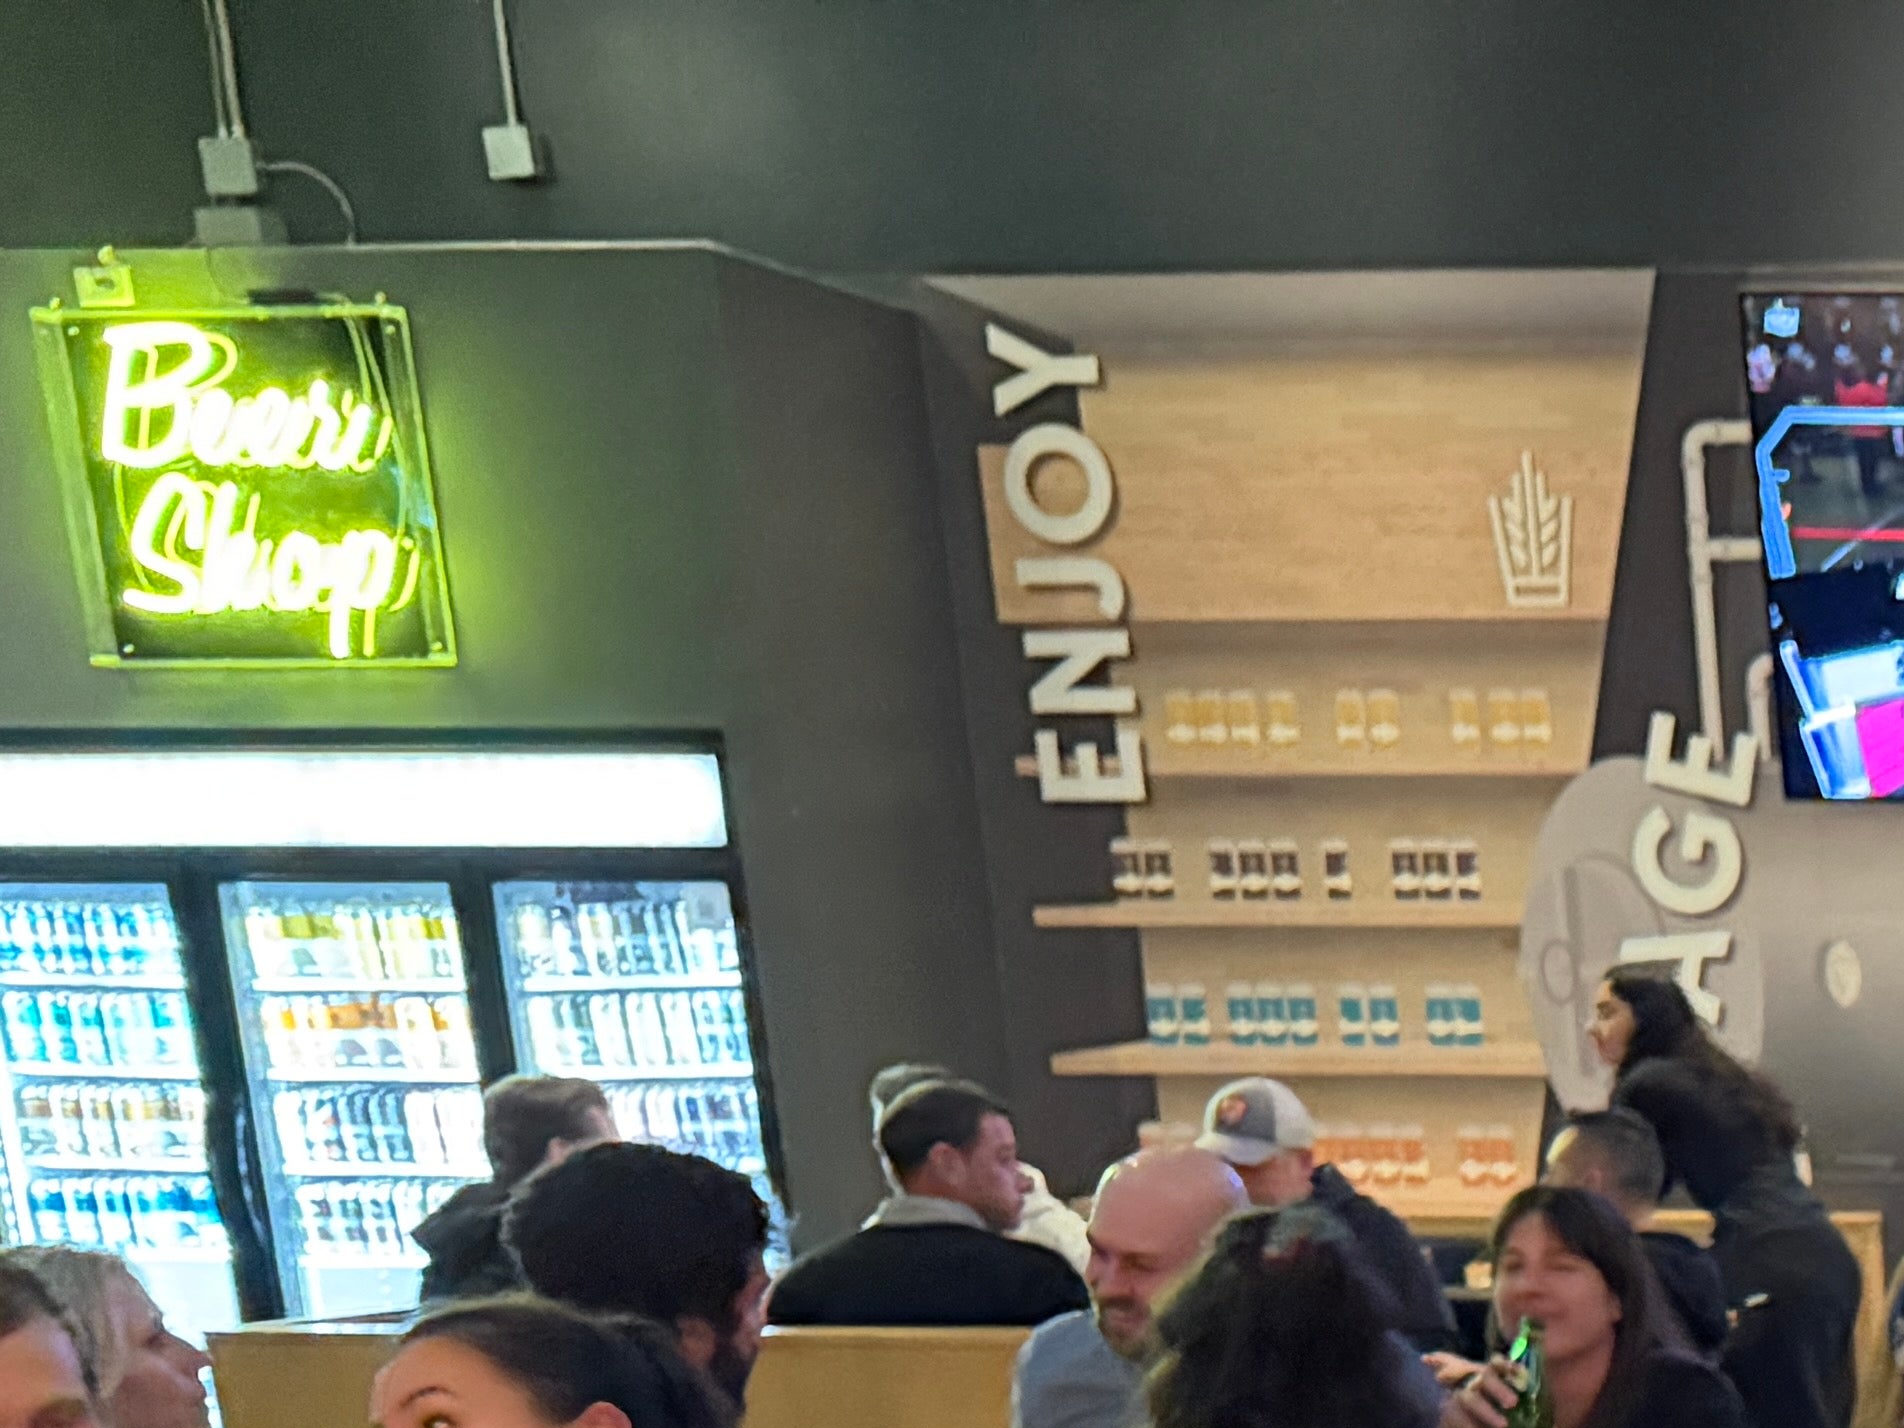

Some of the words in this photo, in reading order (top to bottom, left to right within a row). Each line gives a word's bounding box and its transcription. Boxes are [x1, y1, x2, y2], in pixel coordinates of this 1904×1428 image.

[101, 320, 394, 472] Beer
[122, 474, 416, 660] Shop
[985, 322, 1148, 805] ENJOY
